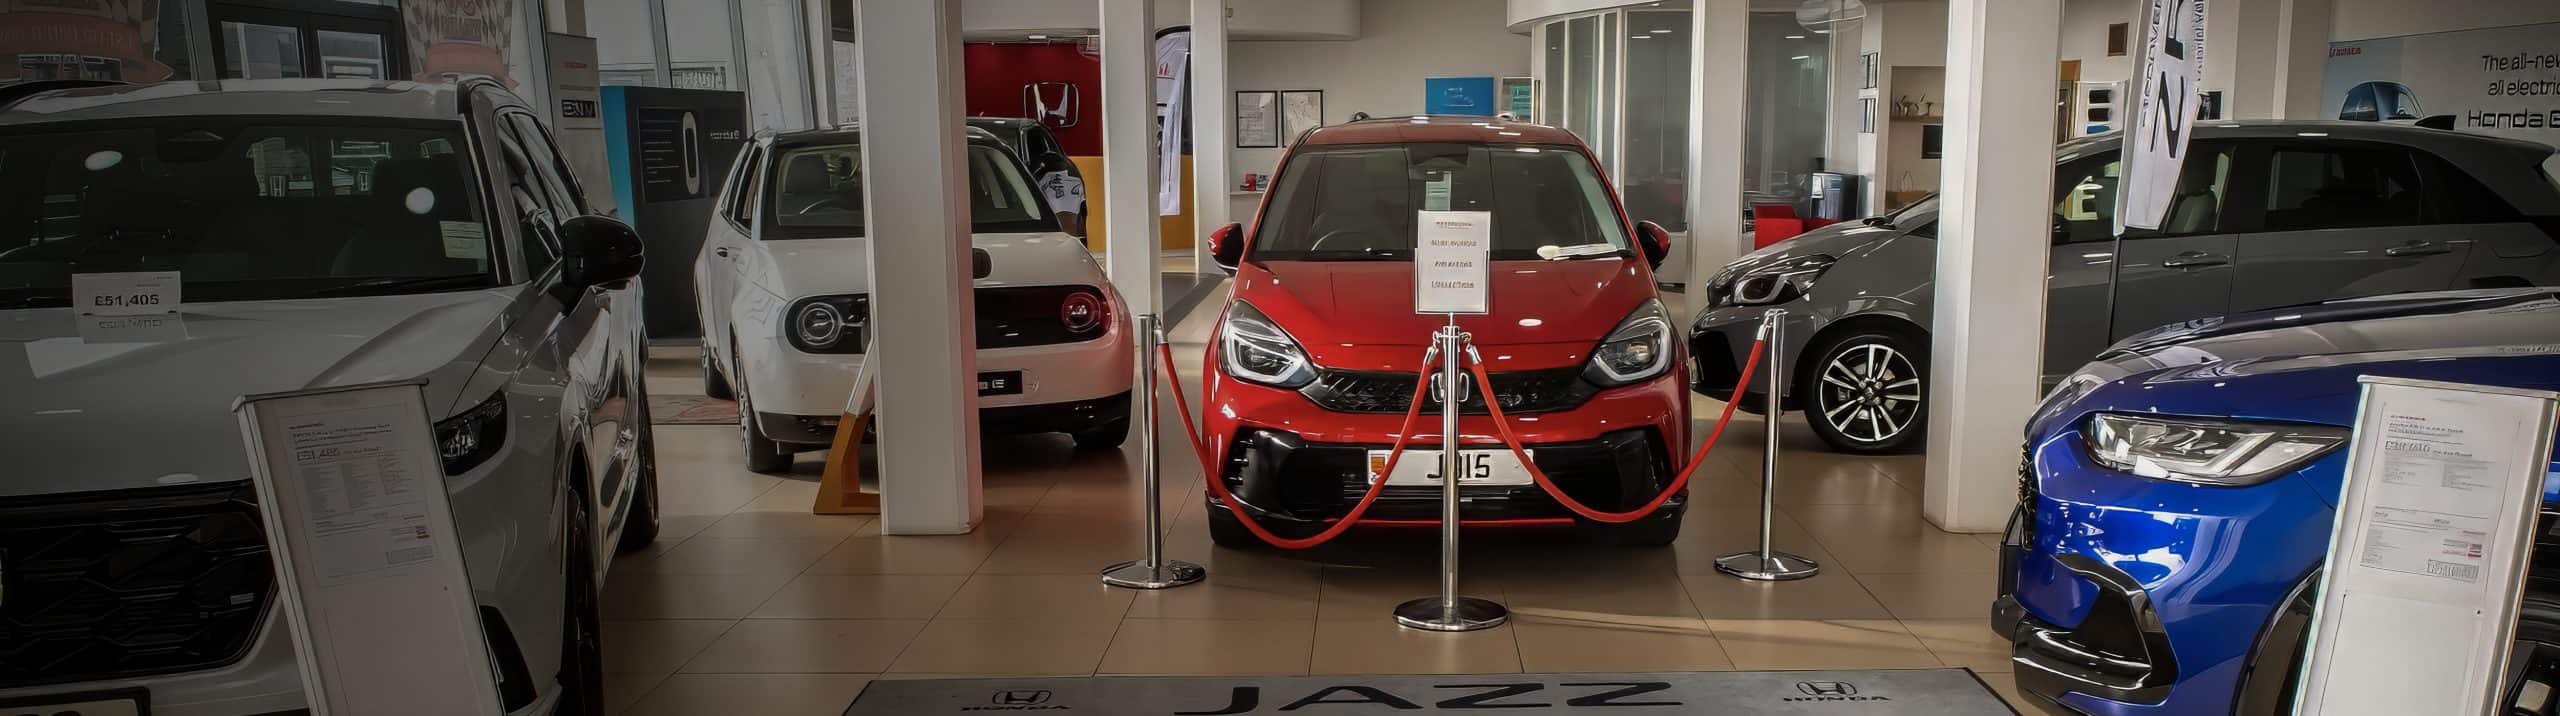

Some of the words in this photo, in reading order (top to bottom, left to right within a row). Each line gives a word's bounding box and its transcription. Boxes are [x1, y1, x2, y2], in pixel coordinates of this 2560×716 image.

[2482, 55, 2508, 71] The
[2488, 79, 2504, 95] all
[2468, 107, 2543, 128] Honda
[95, 294, 160, 307] £51,405
[1174, 682, 1684, 716] JAZZ
